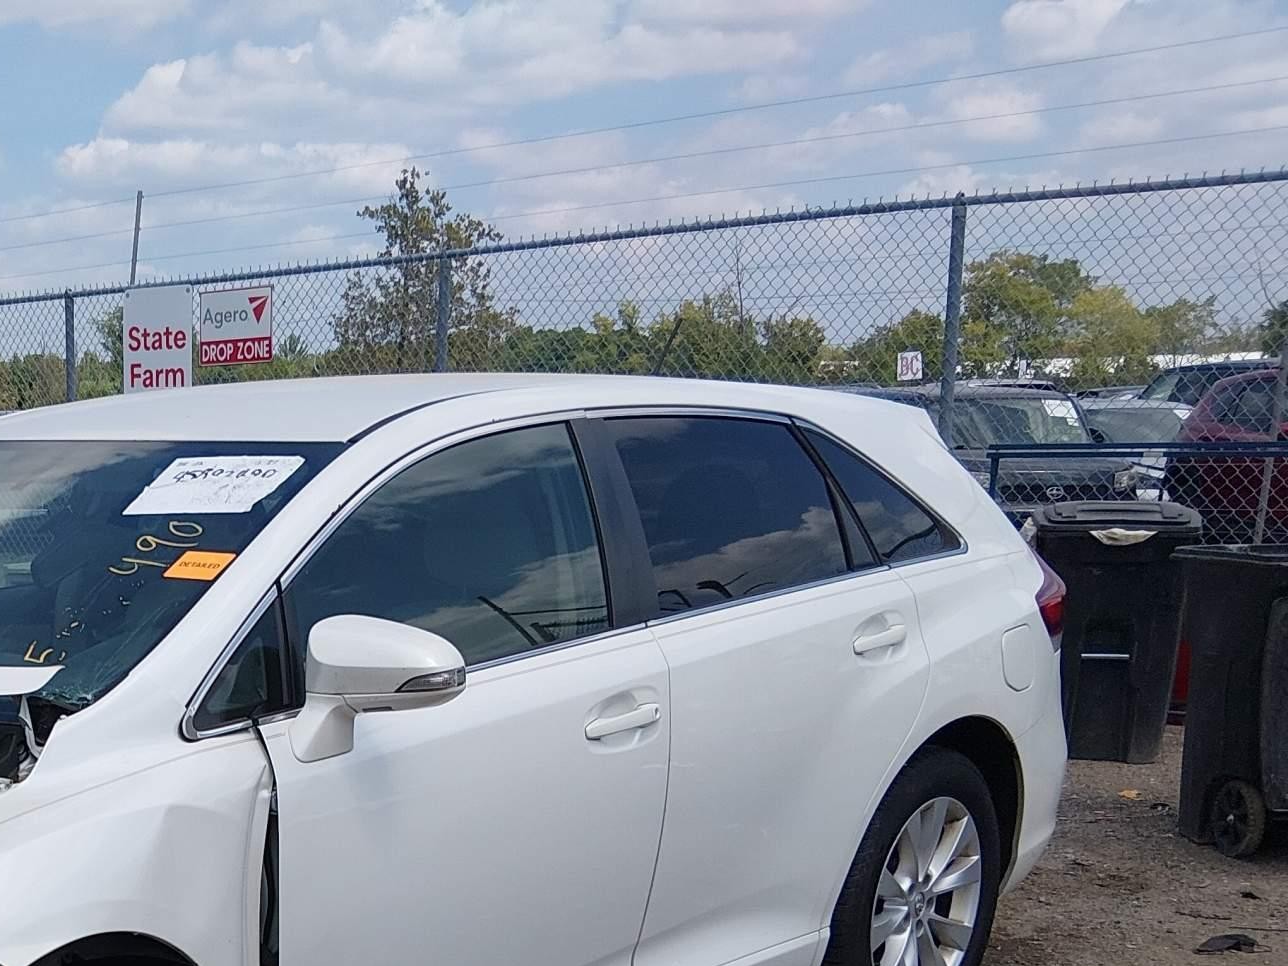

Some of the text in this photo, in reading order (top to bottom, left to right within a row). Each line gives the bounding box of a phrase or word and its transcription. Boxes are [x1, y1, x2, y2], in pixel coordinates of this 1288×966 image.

[203, 308, 248, 328] Agero
[128, 326, 186, 351] State
[202, 340, 270, 362] DROP ZONE
[130, 363, 185, 388] Farm
[899, 353, 920, 377] BC
